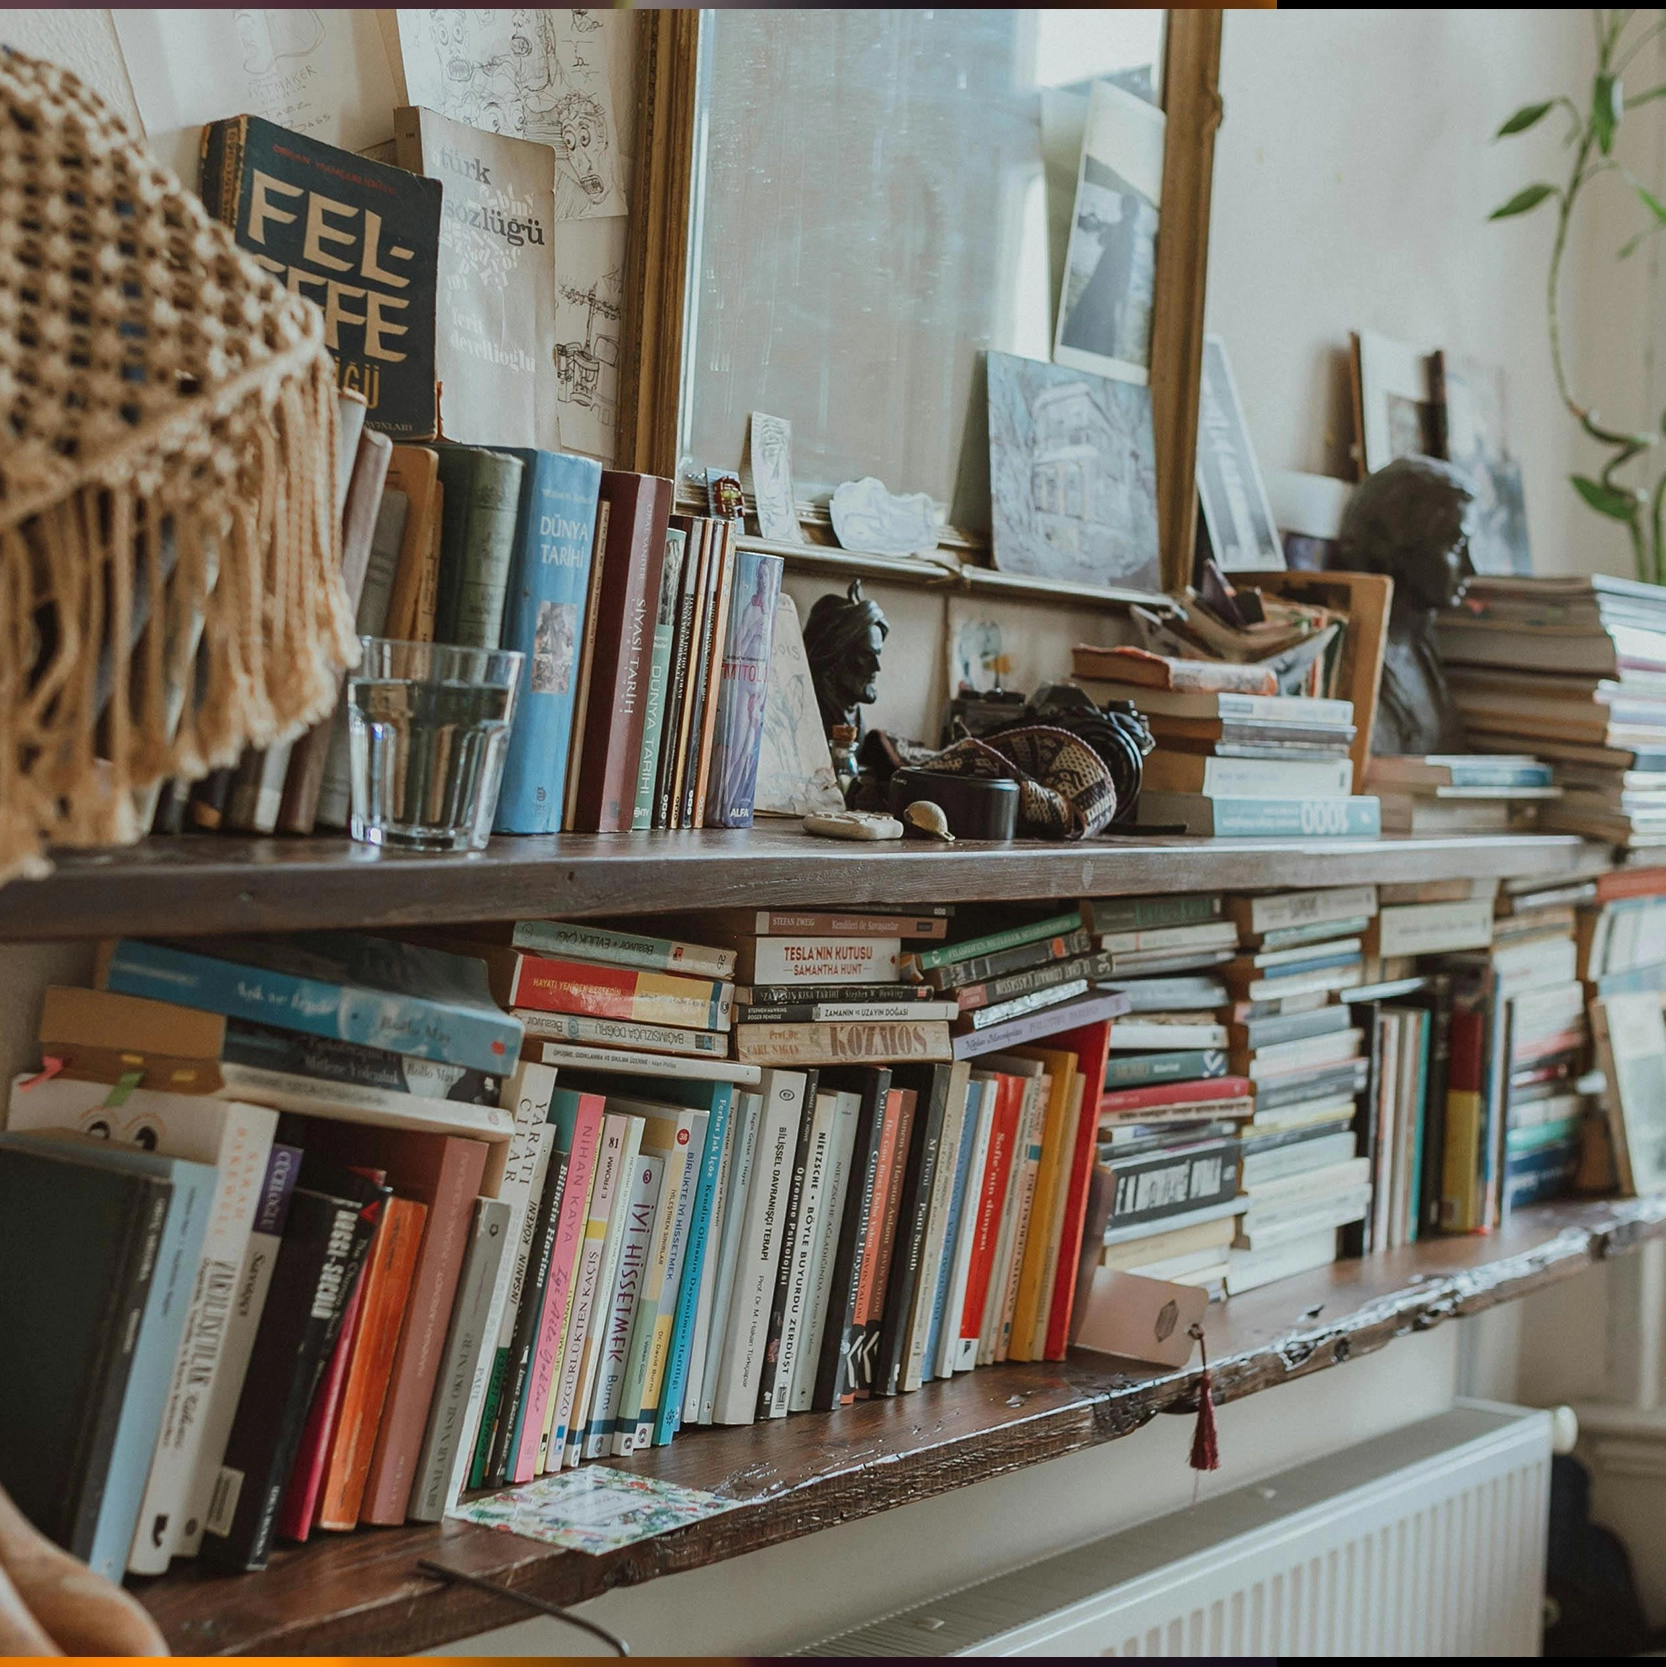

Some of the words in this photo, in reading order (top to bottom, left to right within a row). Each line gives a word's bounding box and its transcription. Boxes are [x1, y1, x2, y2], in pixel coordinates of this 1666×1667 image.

[442, 147, 491, 185] türk
[248, 168, 414, 287] FEL-
[443, 200, 545, 247] sözlüğü
[540, 513, 588, 541] DÜNYA
[641, 503, 652, 534] ORAL
[541, 544, 584, 568] TARİHİ
[638, 536, 650, 580] SANDER
[630, 597, 647, 651] SİYASİ
[623, 655, 640, 714] TARİH
[645, 665, 662, 730] DÜNYA
[639, 736, 654, 794] TARİHİ
[730, 808, 749, 817] ALFA
[773, 917, 796, 926] STEFAN
[796, 918, 815, 927] ZWEIG
[619, 938, 655, 954] Beauvoir
[784, 946, 833, 961] TESLA'NIN
[835, 946, 873, 960] KUTUSU
[533, 978, 558, 989] HAYATI
[794, 964, 839, 976] SAMANTHA
[840, 963, 862, 975] HUNT
[798, 990, 814, 1000] KISA
[816, 989, 839, 999] TARİHİ
[825, 1009, 853, 1017] ZAMANIN
[885, 1007, 908, 1016] DOĞASI
[527, 1018, 563, 1033] Beauvoir
[594, 1023, 627, 1042] DOĞRU
[626, 1028, 684, 1046] BAĞIMSIZLIĞA
[829, 1025, 927, 1057] KOZMOS
[714, 1098, 727, 1132] Ferhat
[726, 1106, 734, 1125] Engin
[748, 1112, 757, 1130] Engin
[876, 1088, 888, 1129] Yalom
[504, 1097, 533, 1184] CILAR
[519, 1100, 547, 1186] YARATI
[709, 1134, 721, 1153] Jak
[723, 1126, 732, 1150] Geçtan
[745, 1132, 754, 1155] Geçtan
[772, 1126, 788, 1167] BİLİŞSEL
[802, 1126, 810, 1142] HOWE
[884, 1119, 894, 1138] Her
[899, 1111, 911, 1148] Annem
[927, 1138, 937, 1151] M
[573, 1124, 593, 1187] NİHAN
[705, 1155, 718, 1179] İçöz
[810, 1131, 827, 1190] NİETZSCHE
[881, 1139, 891, 1162] Gün
[896, 1150, 903, 1162] ve
[987, 1132, 1004, 1196] Sofie'nin
[602, 1155, 614, 1190] FROMM
[680, 1152, 695, 1200] BİRLİKTE
[739, 1165, 749, 1185] Hayat
[876, 1164, 886, 1190] Biraz
[888, 1164, 902, 1206] Hayatın
[922, 1153, 935, 1186] Treni
[548, 1164, 567, 1228] Bilincin
[700, 1184, 713, 1223] Kendin
[763, 1169, 781, 1226] DAVRANIŞÇI
[789, 1166, 804, 1218] Öğrenme
[828, 1161, 842, 1217] NIETZSCHE
[860, 1150, 879, 1236] Günübirlik
[872, 1192, 882, 1216] Daha
[562, 1195, 579, 1244] KAYA
[630, 1201, 653, 1235] İYİ
[662, 1188, 677, 1232] İYİLEŞTİREN
[677, 1202, 688, 1217] İYİ
[801, 1206, 816, 1247] BÖYLE
[883, 1208, 895, 1244] Anlamı
[915, 1202, 927, 1231] Patti
[978, 1199, 994, 1251] dünyası
[657, 1233, 669, 1264] SINIRLAR
[666, 1218, 684, 1281] HİSSETMEK
[691, 1226, 706, 1274] Olmanın
[759, 1227, 774, 1261] TERAPİ
[867, 1217, 878, 1248] Yakın
[509, 1253, 527, 1305] İNSANIN
[521, 1200, 537, 1244] KÖKENİ
[535, 1230, 554, 1289] Haritası
[779, 1222, 796, 1286] Psikolojisi
[816, 1219, 833, 1291] AĞLADIĞINDA
[862, 1253, 872, 1278] IRVIN
[878, 1249, 888, 1271] IRVIN
[909, 1233, 922, 1271] Smith
[755, 1275, 764, 1293] Prof.
[791, 1251, 807, 1313] BUYURDU
[848, 1241, 865, 1309] Hayatlar
[873, 1272, 884, 1312] YALOM
[607, 1243, 643, 1363] HİSSETMEK
[679, 1276, 697, 1339] Dayanılmaz
[752, 1308, 759, 1318] M.
[856, 1280, 868, 1319] YALOM
[559, 1301, 588, 1418] ÖZGÜRLÜKTEN
[581, 1250, 597, 1297] KAÇIŞ
[749, 1320, 758, 1346] Hakan
[780, 1317, 797, 1375] ZERDÜŞT
[653, 1344, 661, 1367] David
[670, 1343, 686, 1390] Hafifliği
[740, 1347, 754, 1388] Türkçapar
[602, 1373, 617, 1412] Burns
[649, 1368, 657, 1393] Burns
